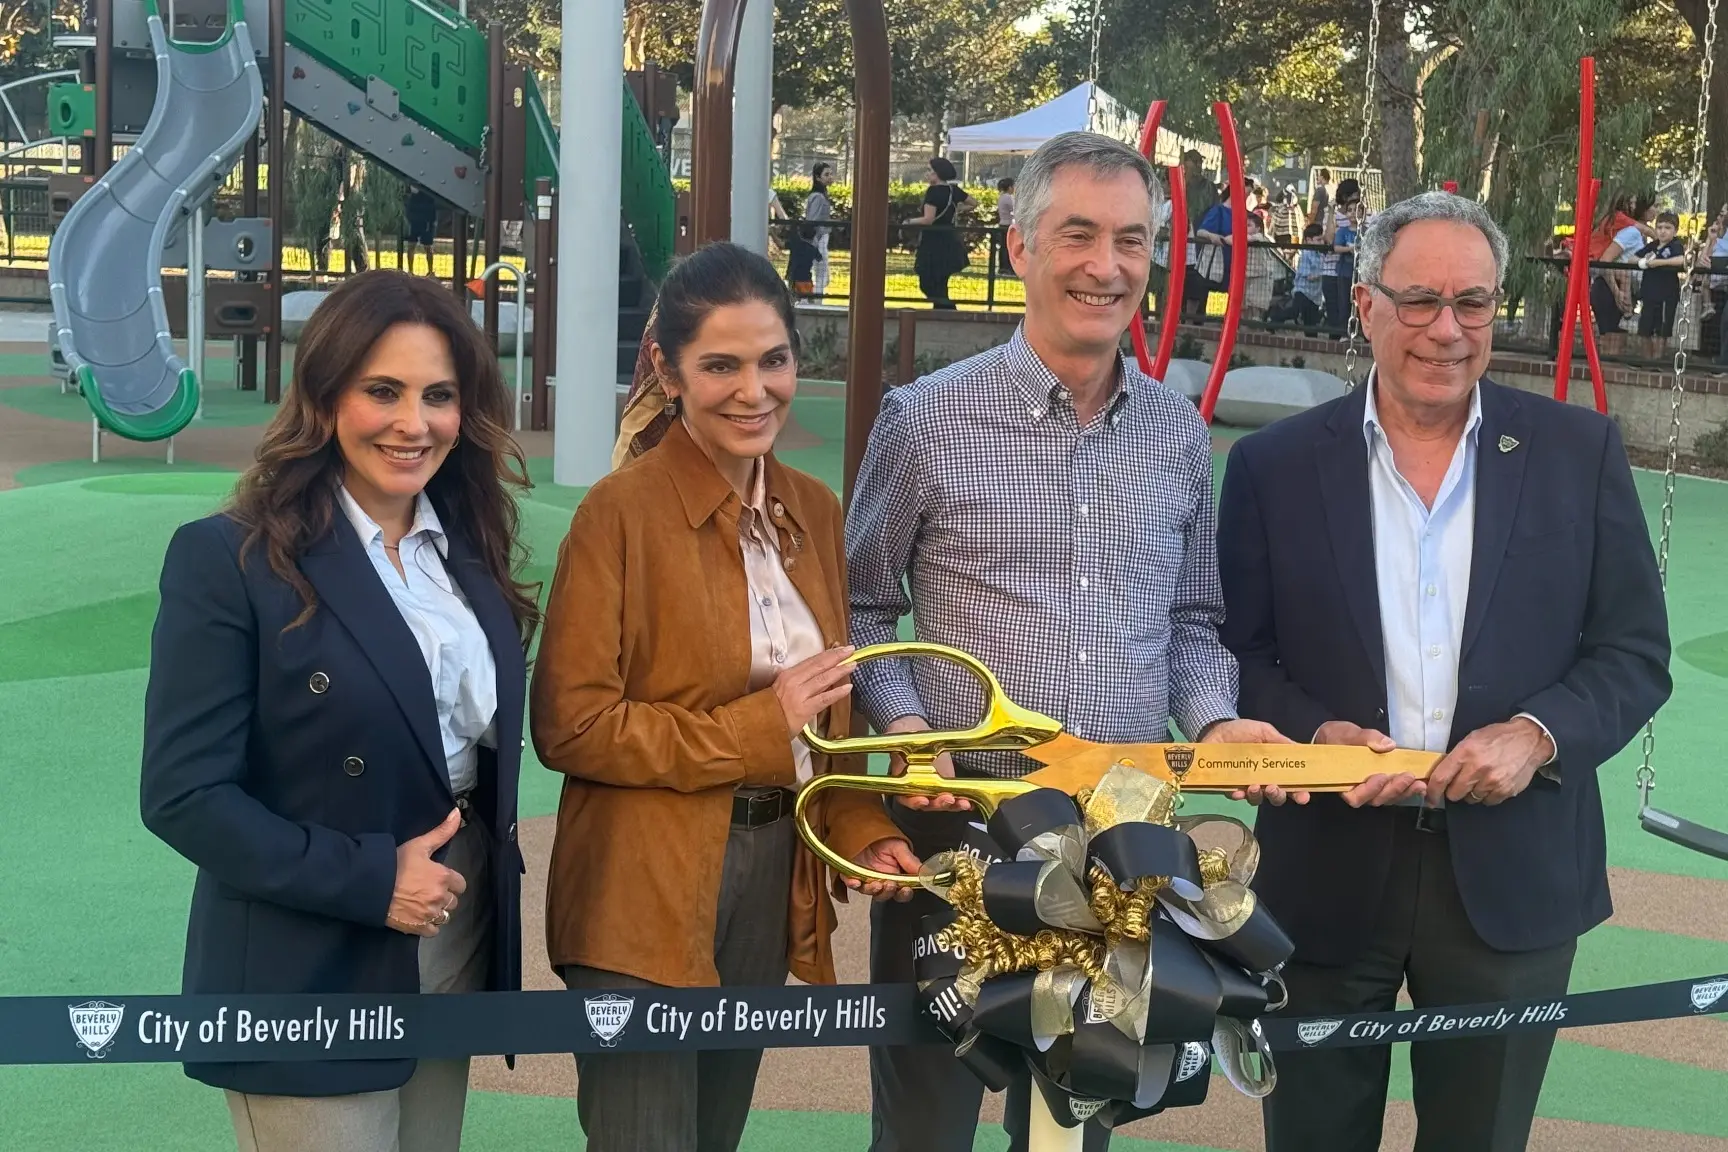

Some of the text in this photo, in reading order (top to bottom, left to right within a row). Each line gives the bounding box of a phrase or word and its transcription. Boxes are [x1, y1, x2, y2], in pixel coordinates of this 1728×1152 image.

[379, 63, 385, 73] 7
[1171, 760, 1188, 768] HILLS
[1197, 757, 1306, 771] Community Services
[929, 983, 968, 1022] ills
[590, 1005, 628, 1016] BEVERLY
[76, 1014, 117, 1024] BEVERLY
[595, 1016, 621, 1026] HILLS
[646, 995, 886, 1041] City of Beverly Hills
[1349, 1001, 1569, 1040] City of Beverly Hills
[82, 1025, 110, 1035] HILLS
[138, 1005, 405, 1051] City of Beverly Hills
